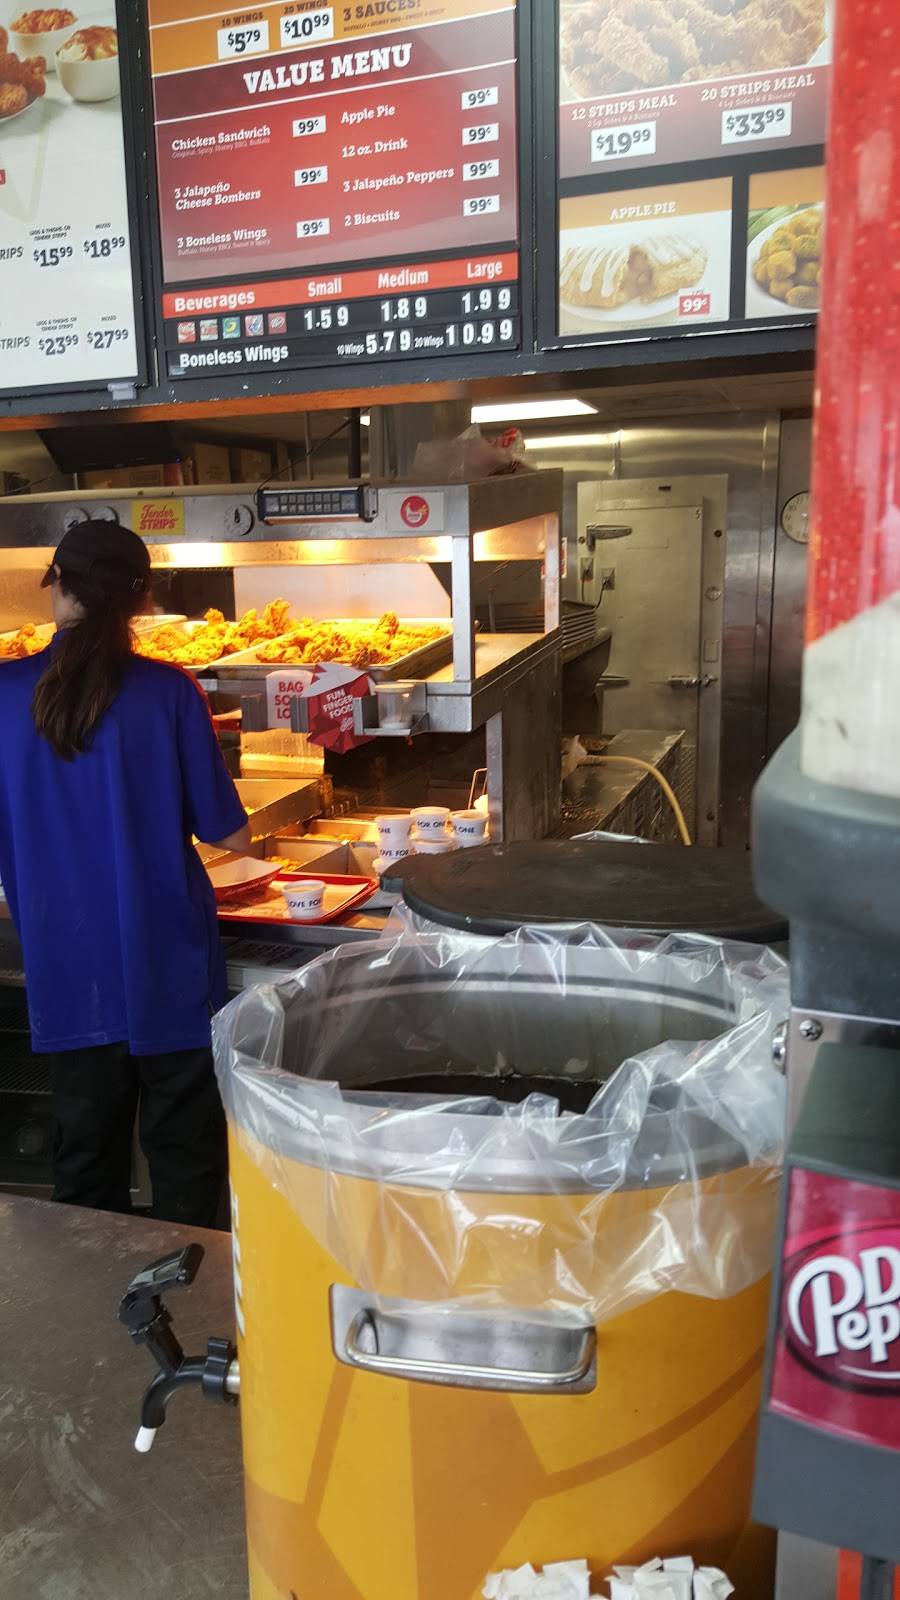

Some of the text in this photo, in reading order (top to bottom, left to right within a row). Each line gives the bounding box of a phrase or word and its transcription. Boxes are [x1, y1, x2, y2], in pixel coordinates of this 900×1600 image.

[284, 0, 328, 14] 20 WINGS
[343, 0, 422, 21] 3 SAUCES!
[222, 12, 264, 26] 10 WINGS
[243, 43, 412, 94] VALUE MENU
[701, 73, 816, 101] 20 STRIPS MEAL
[341, 104, 396, 125] Apple Pie
[571, 94, 677, 121] 12 STRIPS MEAL
[172, 125, 271, 151] Chicken Sandwich
[341, 138, 408, 158] 12 oz. Drink
[343, 167, 455, 193] 3 Jalapeño Peppers
[174, 182, 231, 200] 3 Jalapeño
[176, 189, 262, 211] Cheese Bombers
[344, 210, 401, 227] 2 Biscuits
[610, 201, 677, 221] APPLE PIE
[177, 228, 268, 249] 3 Boneless Wings
[174, 261, 503, 313] Beverages Small Medium Large
[0, 335, 30, 350] TRIPS
[180, 349, 242, 368] Boneless
[244, 345, 289, 363] Wings
[140, 518, 178, 530] STRIPS
[279, 681, 304, 693] BAG
[326, 688, 346, 702] FUN
[323, 694, 353, 713] FINGER
[458, 826, 475, 834] ONE
